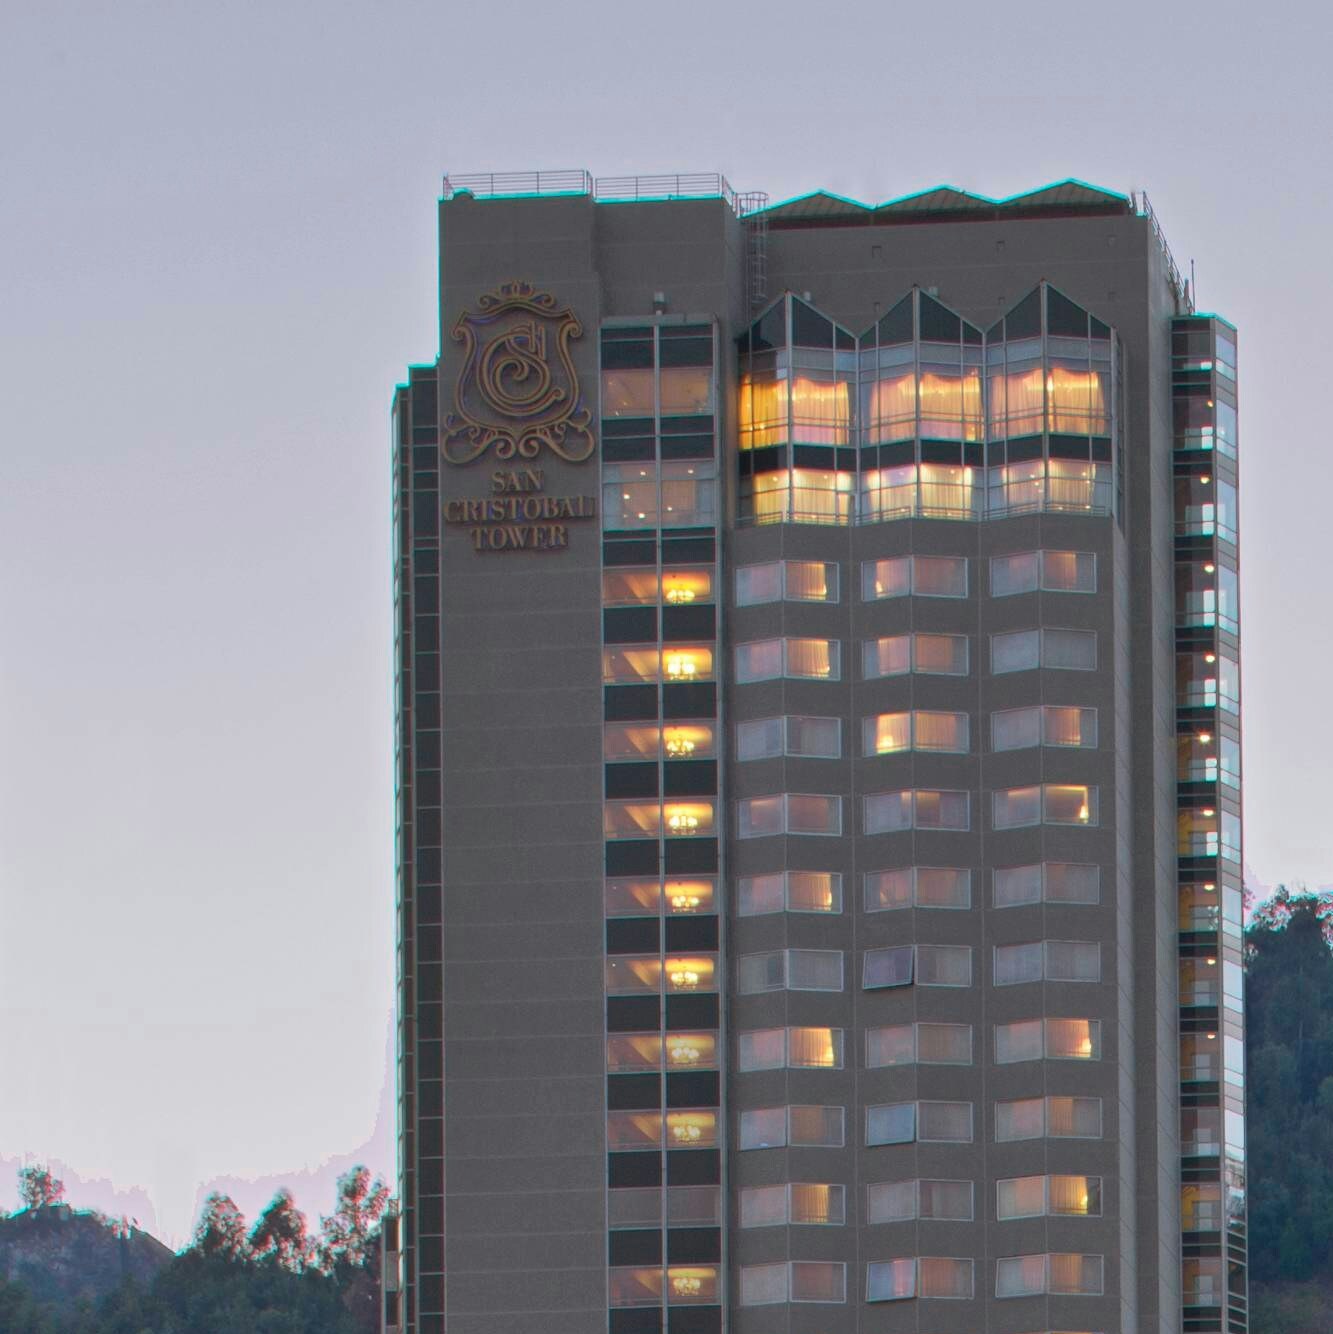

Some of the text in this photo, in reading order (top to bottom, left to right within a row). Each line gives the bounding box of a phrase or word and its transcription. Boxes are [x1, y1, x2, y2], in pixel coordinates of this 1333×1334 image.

[491, 468, 545, 492] SAN
[444, 497, 595, 521] CRISTOBAL
[471, 524, 568, 550] TOWER
